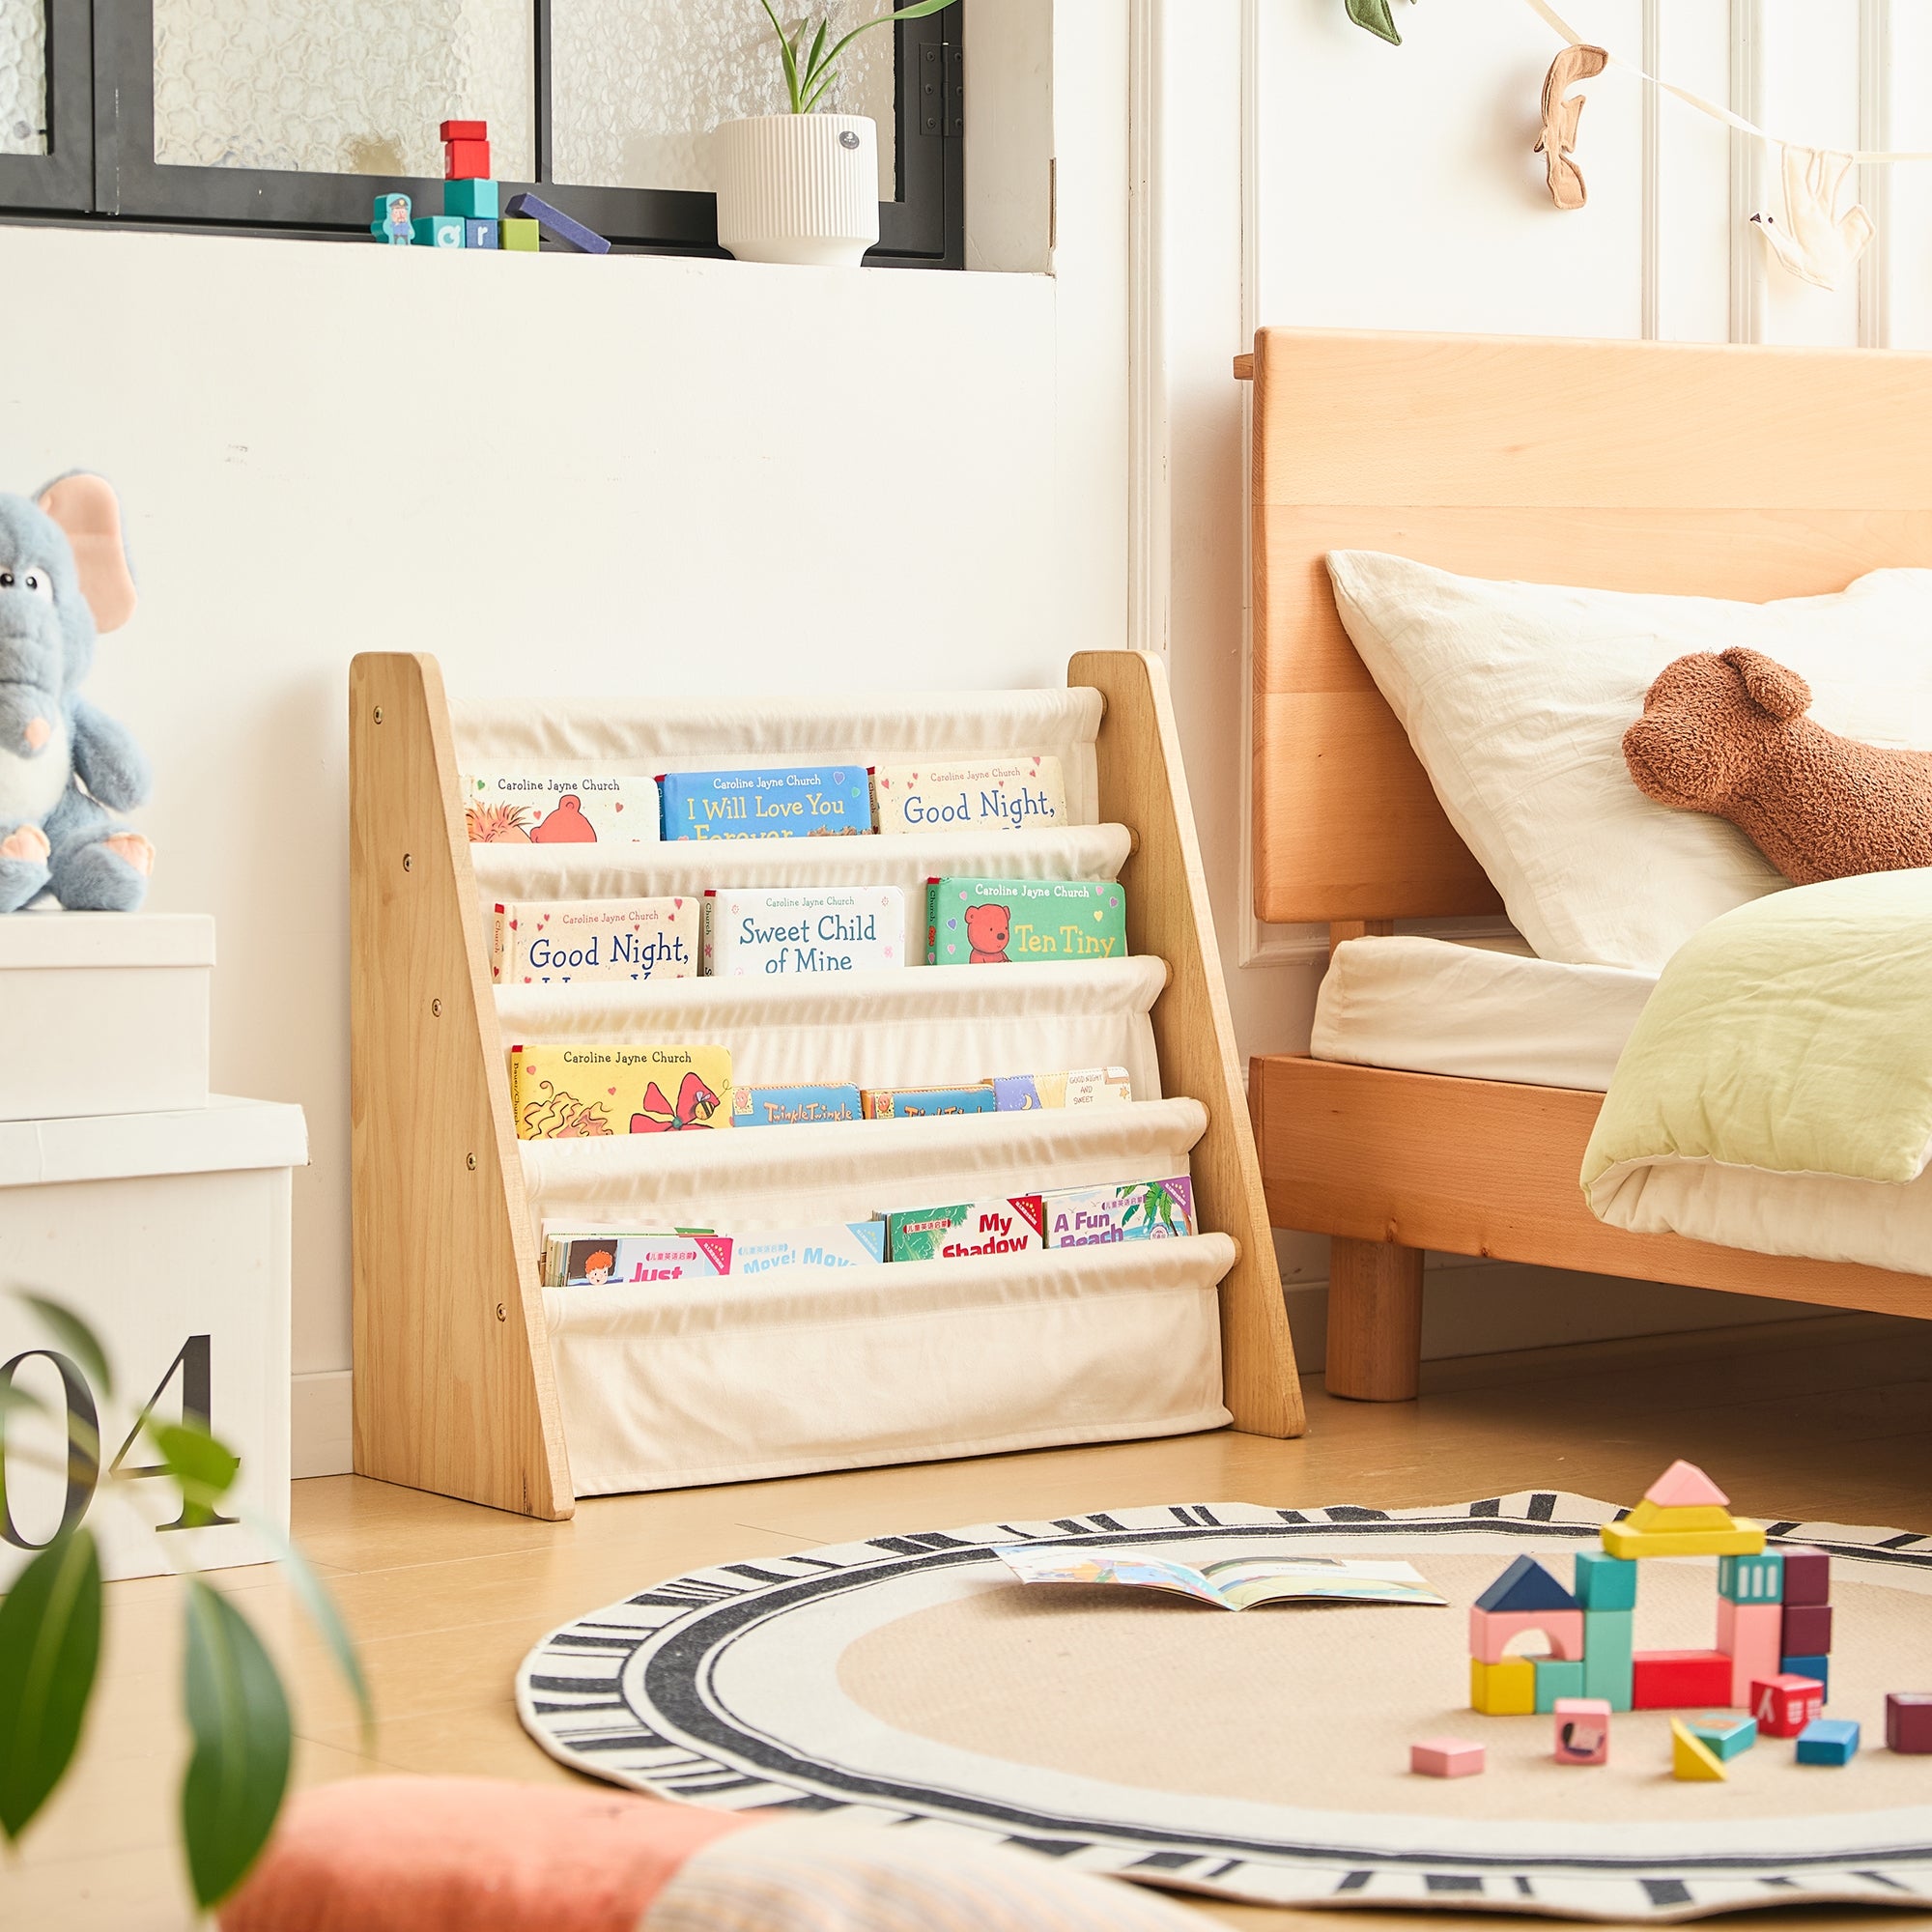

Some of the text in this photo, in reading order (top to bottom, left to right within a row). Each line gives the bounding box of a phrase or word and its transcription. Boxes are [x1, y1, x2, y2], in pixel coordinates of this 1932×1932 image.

[713, 774, 821, 790] Caroline Jayne Church
[930, 766, 1021, 782] Caroline Jayne Church
[497, 779, 620, 793] Caroline Jayne Church
[687, 798, 696, 820] I
[702, 795, 747, 821] Will
[755, 795, 804, 818] Love
[806, 793, 845, 816] You
[904, 787, 1055, 824] Good Night,
[975, 883, 1090, 898] Caroline Jayne Church
[765, 896, 855, 909] Caroline Jayne Church
[562, 910, 659, 924] Caroline Jayne Church
[739, 914, 877, 945] Sweet Child
[1014, 923, 1116, 959] Ten Tiny
[530, 931, 689, 971] Good Night,
[765, 947, 853, 974] of Mine
[563, 1050, 692, 1065] Caroline Jayne Church
[1072, 1095, 1094, 1105] SWEET
[979, 1212, 1013, 1236] My
[1054, 1211, 1110, 1234] A Fun
[942, 1235, 1029, 1259] Shadow
[743, 1249, 796, 1274] Move!
[803, 1247, 858, 1267] Mov
[629, 1262, 683, 1283] Just
